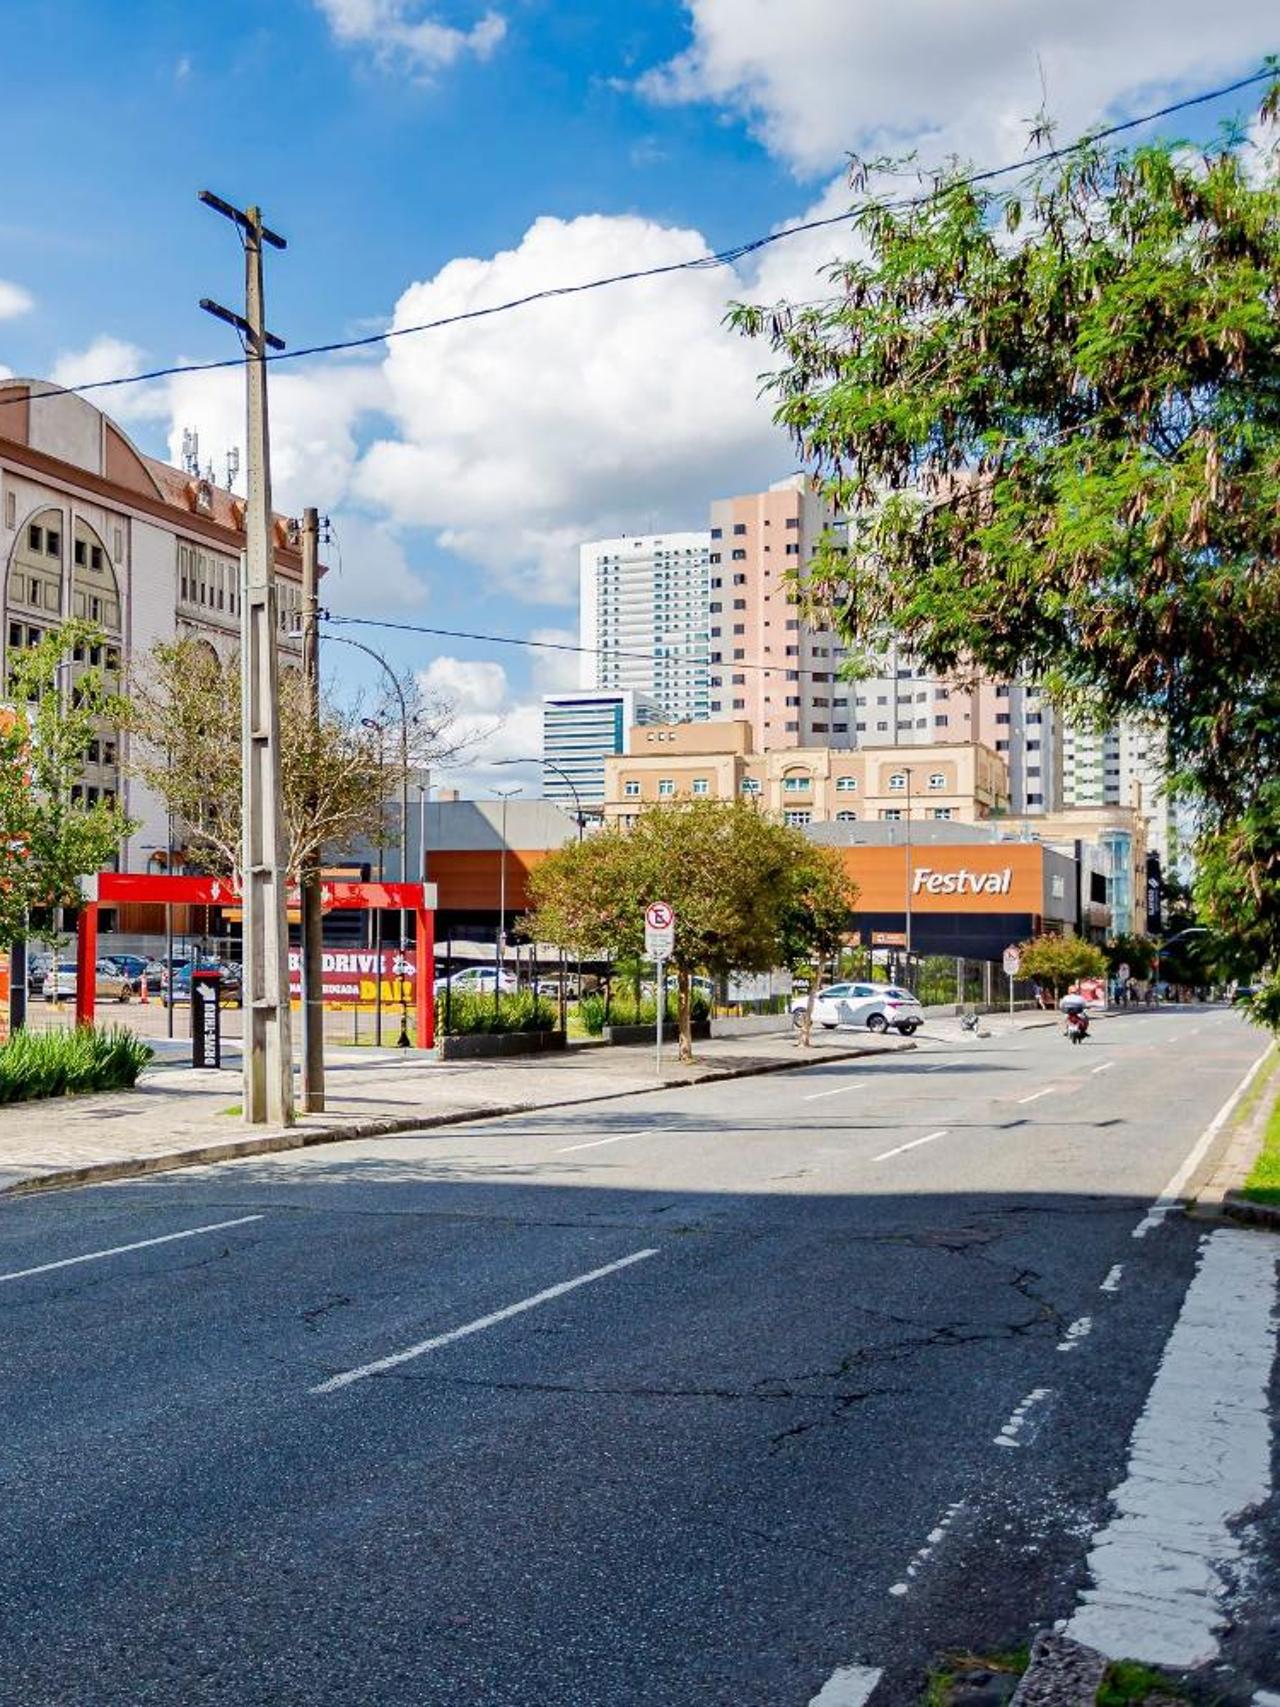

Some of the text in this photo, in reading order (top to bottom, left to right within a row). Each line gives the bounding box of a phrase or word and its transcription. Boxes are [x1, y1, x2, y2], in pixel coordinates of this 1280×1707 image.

[912, 867, 1012, 895] Festval
[321, 953, 386, 973] DRIVE
[204, 1003, 216, 1066] DRIVE-THRU
